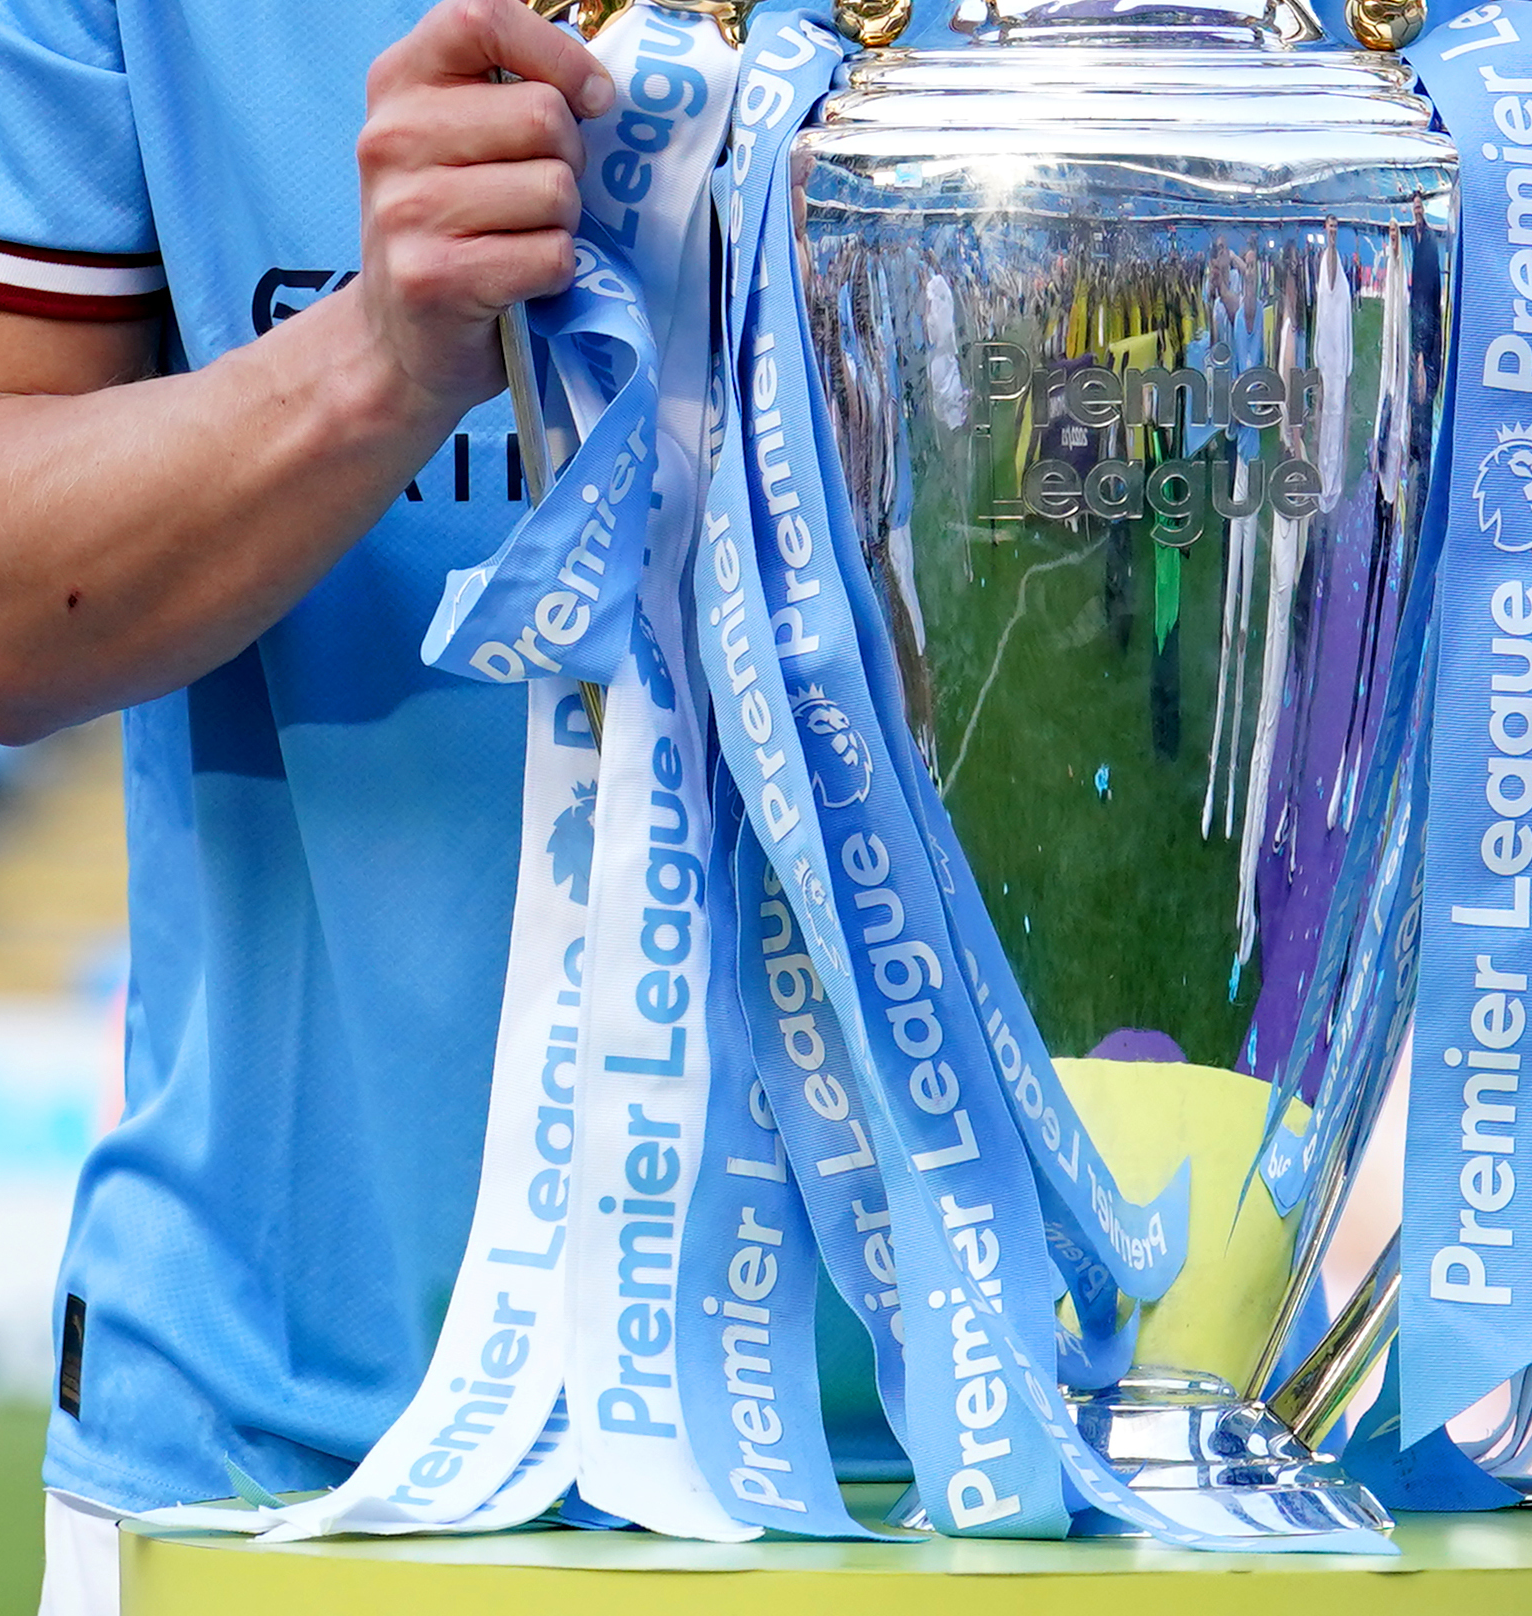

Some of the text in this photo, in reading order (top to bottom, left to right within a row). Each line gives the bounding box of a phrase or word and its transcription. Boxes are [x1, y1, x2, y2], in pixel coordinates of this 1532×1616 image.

[752, 333, 823, 660] Premier
[973, 341, 1325, 428] Premier
[976, 434, 1325, 547] League
[468, 415, 648, 682] Premier
[708, 510, 801, 844] Premier
[597, 736, 705, 1440] Premier League
[844, 830, 980, 1173] League
[1429, 951, 1528, 1307] Premier
[386, 1291, 539, 1507] remier
[702, 1205, 808, 1514] Premier
